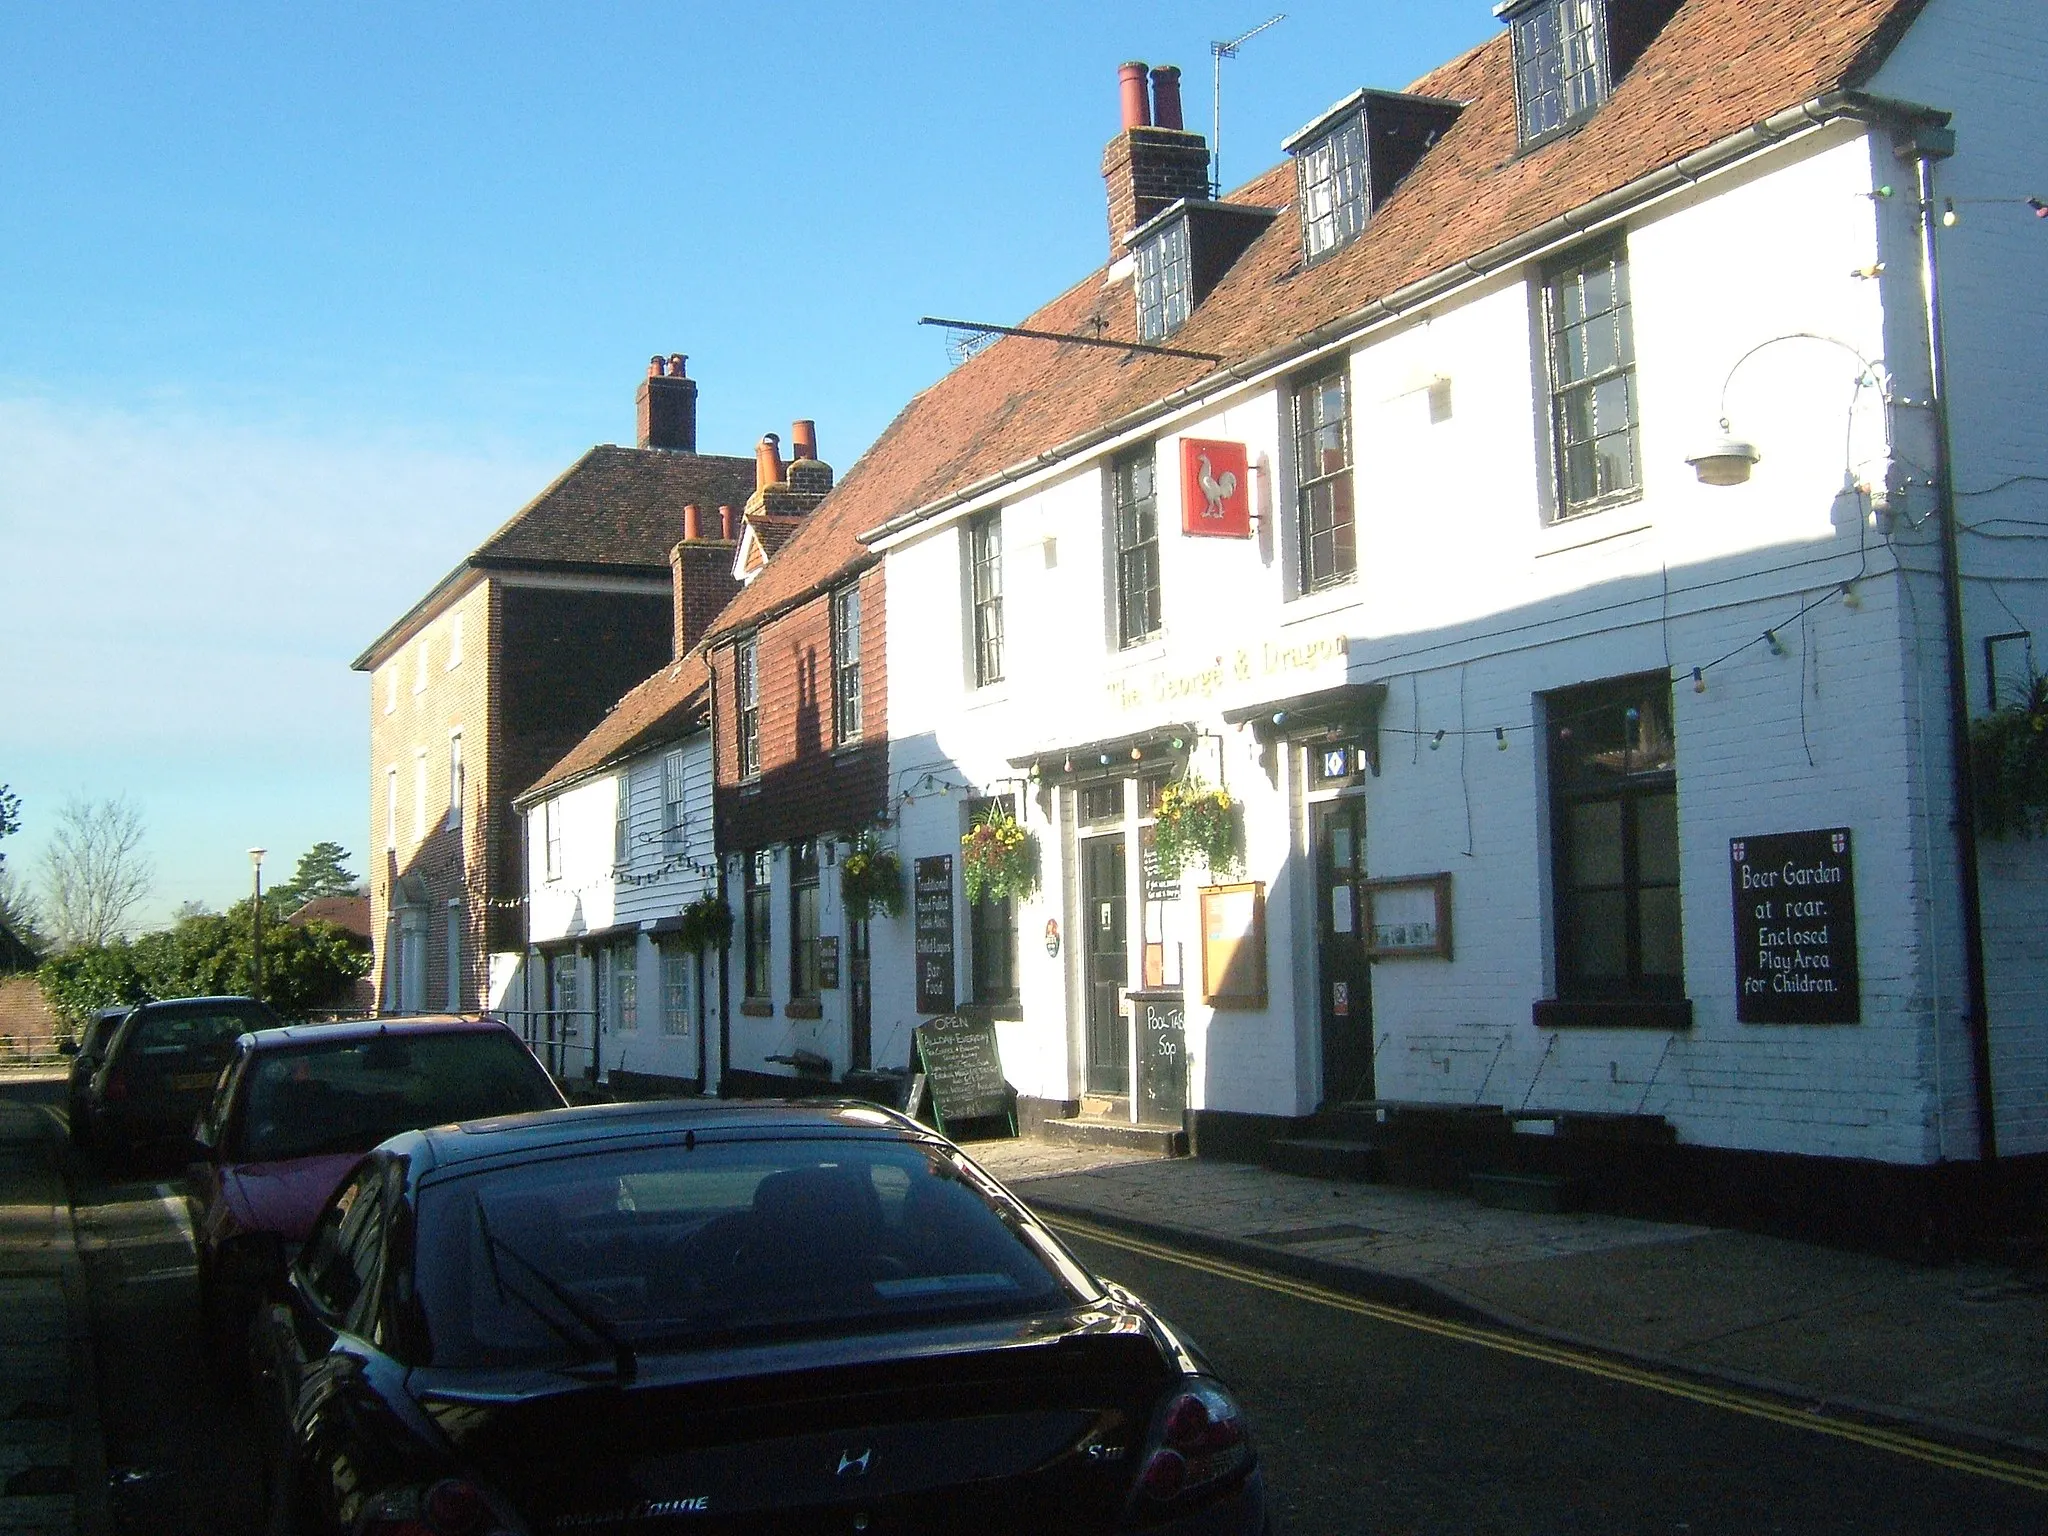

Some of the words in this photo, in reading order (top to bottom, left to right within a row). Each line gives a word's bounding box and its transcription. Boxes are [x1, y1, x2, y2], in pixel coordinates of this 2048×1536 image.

[1153, 668, 1223, 701] George
[1264, 634, 1349, 674] Dragon
[1742, 865, 1779, 889] Beer
[1783, 861, 1841, 887] Garden
[1755, 901, 1771, 919] at
[1786, 899, 1827, 918] rear.
[1759, 926, 1828, 946] Enclosed
[1759, 951, 1791, 973] Play
[1794, 950, 1830, 969] Area
[925, 979, 943, 995] Food
[1745, 977, 1765, 994] for
[1773, 974, 1838, 993] Children.
[935, 1016, 969, 1031] OPEN
